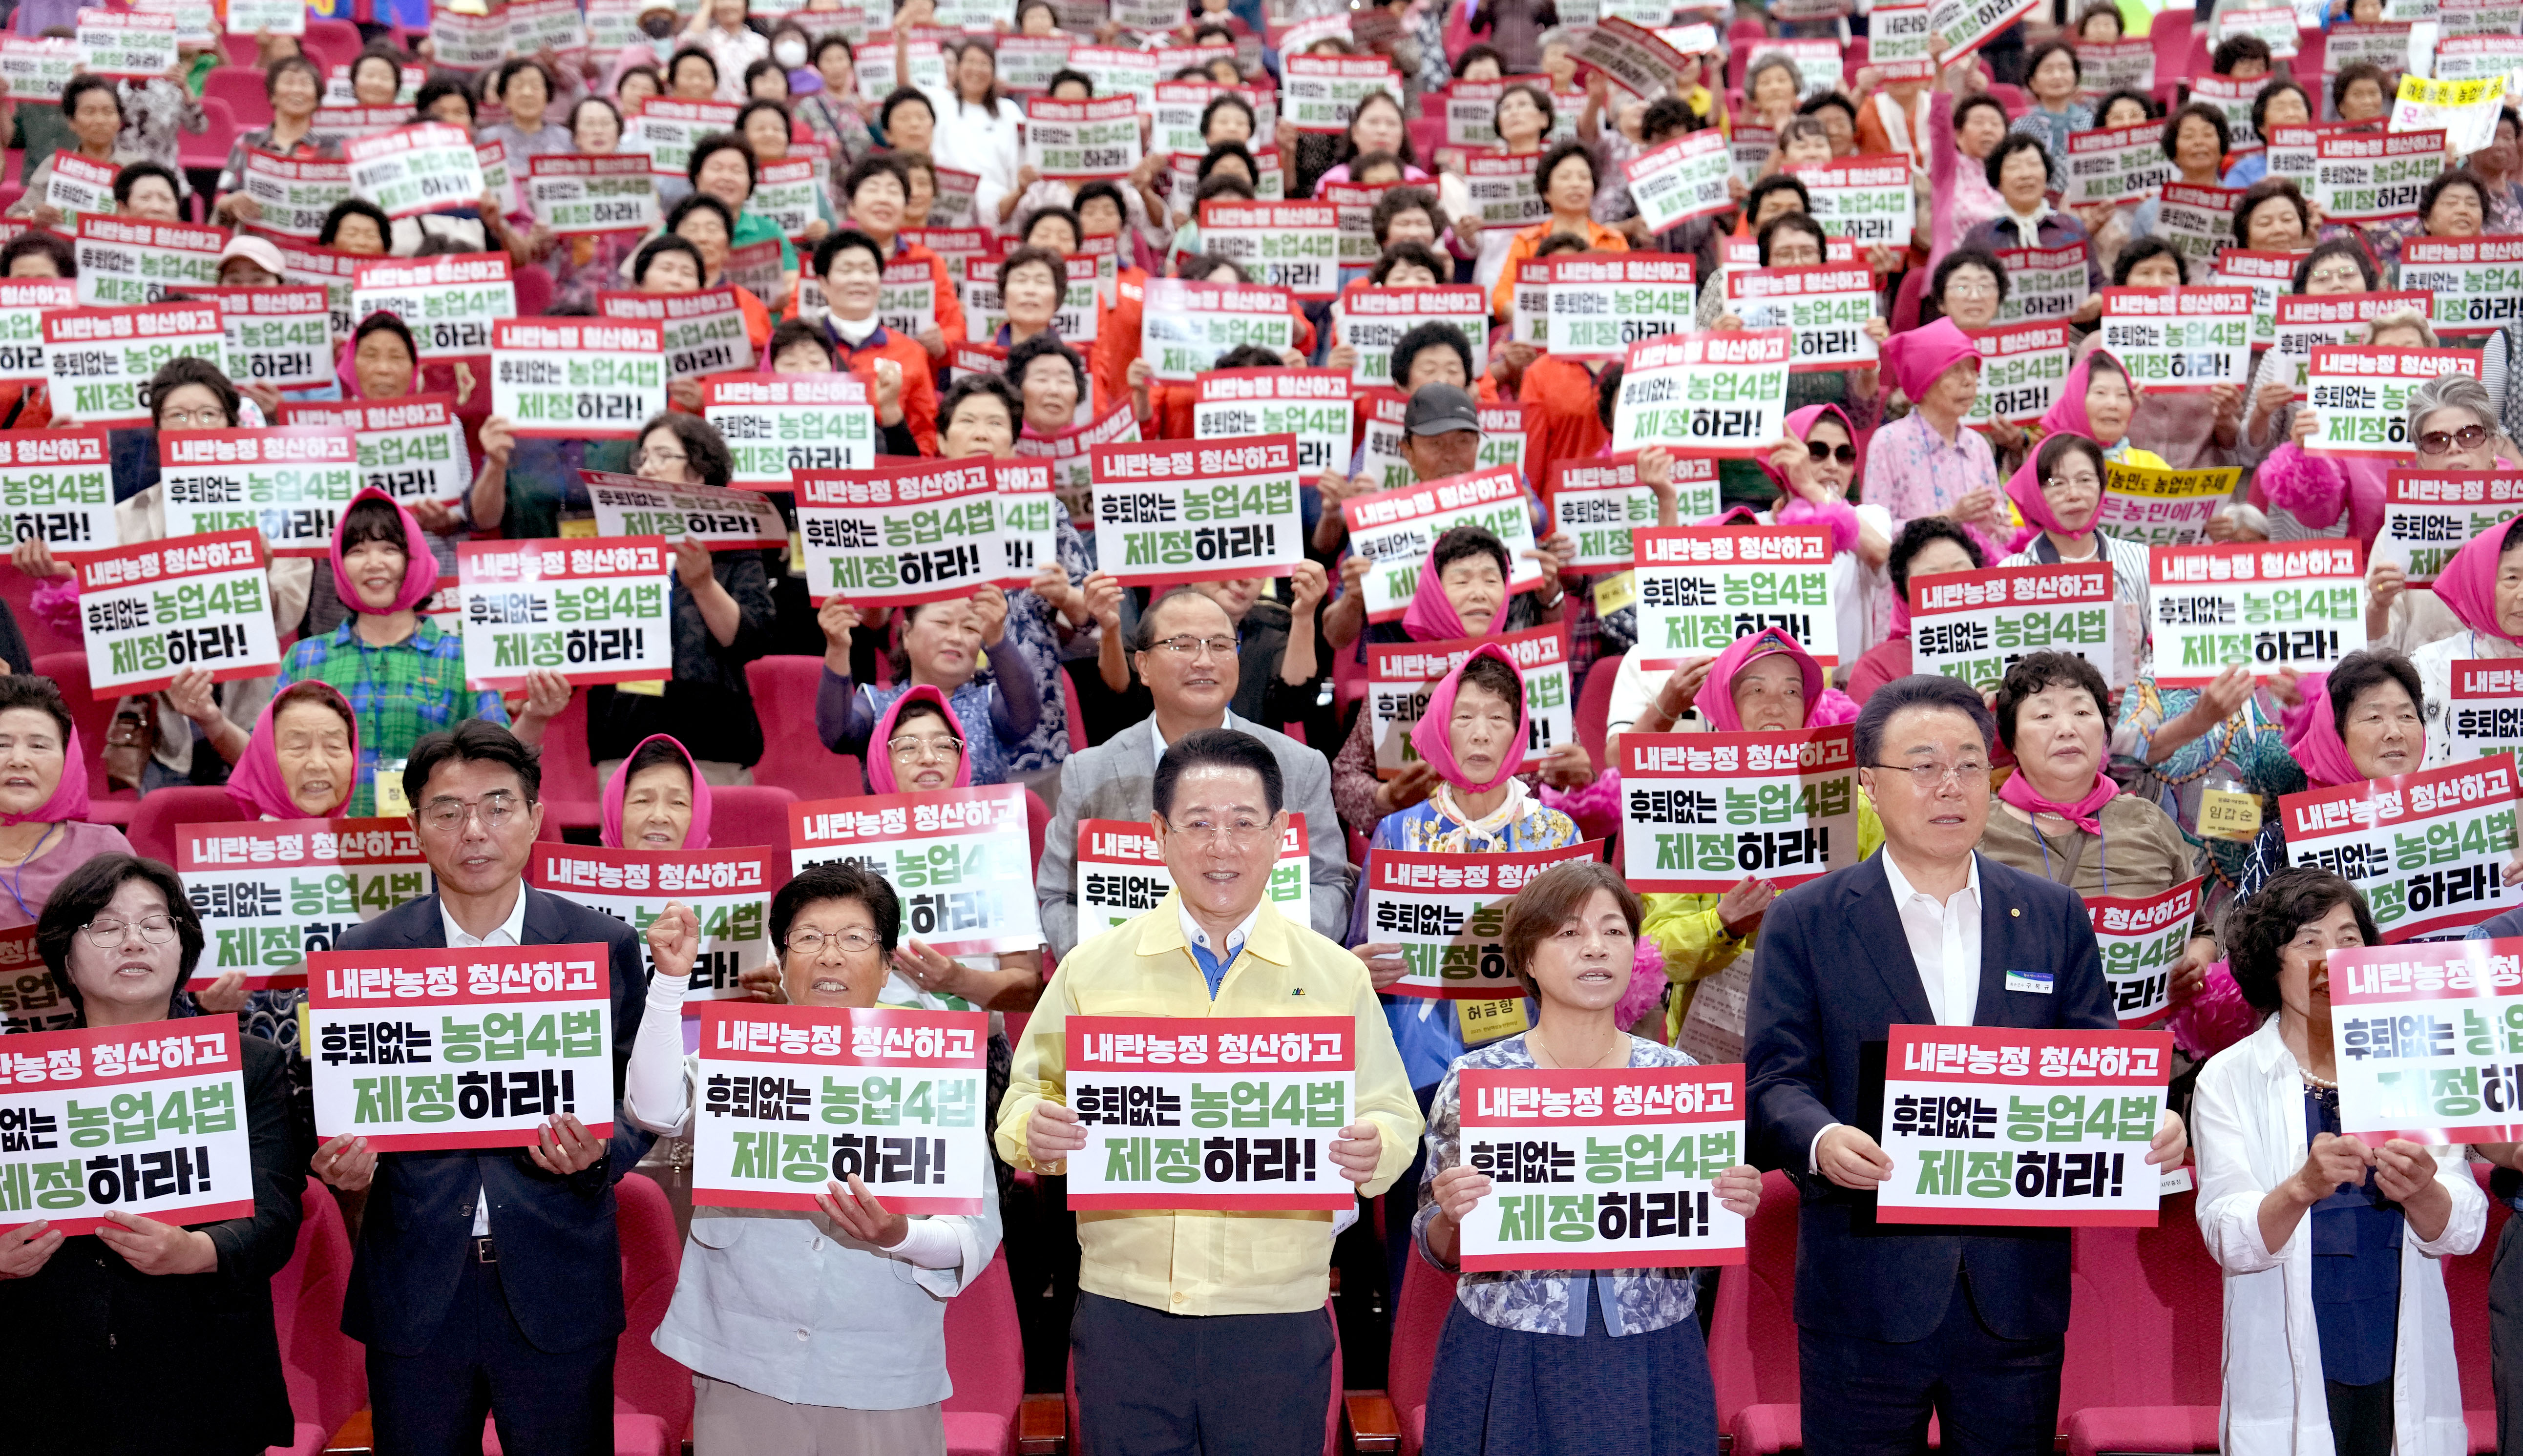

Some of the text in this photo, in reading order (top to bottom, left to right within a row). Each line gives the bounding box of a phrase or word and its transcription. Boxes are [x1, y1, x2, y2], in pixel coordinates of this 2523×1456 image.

[519, 394, 642, 419] 제정하라!
[1637, 402, 1761, 437] 제정하라!
[17, 438, 101, 462] 청산하고
[172, 435, 349, 461] 내란농정 청산하고
[1103, 452, 1194, 477] 내란농정
[1199, 445, 1289, 473] 청산하고
[3, 473, 105, 505] 농업4법
[171, 471, 352, 503] 후퇴없는 농업4법
[805, 466, 988, 502] 내란농정 청산하고
[1102, 480, 1292, 523] 후퇴없는 농업4법
[1357, 477, 1515, 527] 내란농정 청산하고
[2398, 479, 2483, 500] 내란농정
[807, 500, 994, 547] 후퇴없는 농업4법
[2392, 514, 2462, 540] 후퇴없는
[85, 541, 255, 587] 내란농정 청산하고
[471, 547, 659, 577] 내란농정 청산하고
[1125, 524, 1275, 564] 제정하라!
[1646, 536, 1824, 561] 내란농정 청산하고
[830, 544, 980, 587] 제정하라!
[2162, 550, 2354, 581] 내란농정 청산하고
[88, 578, 262, 633] 후퇴없는 농업4법
[470, 584, 661, 624] 후퇴없는 농업4법
[1644, 573, 1827, 607] 후퇴없는 농업4법
[1922, 574, 2104, 609] 내란농정 청산하고
[2160, 588, 2357, 624] 후퇴없는 농업4법
[106, 623, 247, 675] 제정하라!
[494, 628, 643, 666] 제정하라!
[1920, 609, 2105, 652] 후퇴없는 농업4법
[2183, 630, 2338, 664] 제정하라!
[1635, 738, 1848, 771] 내란농정 청산하고
[804, 798, 1012, 841] 내란농정 청산하고
[1631, 777, 1850, 825] 후퇴없는 농업4법
[2297, 768, 2510, 832] 내란농정 청산하고
[193, 830, 419, 863] 내란농정 청산하고
[1656, 827, 1829, 871] 제정하라!
[2395, 810, 2519, 871] 농업4법
[548, 858, 761, 890] 내란농정 청산하고
[1385, 863, 1489, 888] 내란농정
[189, 872, 422, 919] 후퇴없는 농업4법
[2103, 889, 2192, 930] 청산하고
[1377, 901, 1464, 936] 후퇴없는
[327, 961, 597, 998] 내란농정 청산하고
[2347, 959, 2475, 994] 내란농정
[92, 1033, 228, 1076] 청산하고
[322, 1009, 601, 1066] 후퇴없는 농업4법
[717, 1020, 974, 1058] 내란농정 청산하고
[1084, 1033, 1342, 1064] 내란농정 청산하고
[2344, 1016, 2454, 1060] 후퇴없는
[1905, 1043, 2159, 1077] 내란농정 청산하고
[67, 1082, 236, 1149] 농업4법
[354, 1069, 576, 1122] 제정하라!
[706, 1074, 975, 1126] 후퇴없는 농업4법
[1077, 1081, 1344, 1128] 후퇴없는 농업4법
[1478, 1082, 1733, 1117] 내란농정 청산하고
[1893, 1095, 2157, 1144] 후퇴없는 농업4법
[732, 1132, 945, 1184] 제정하라!
[1105, 1137, 1315, 1183] 제정하라!
[1471, 1131, 1736, 1186] 후퇴없는 농업4법
[1916, 1150, 2124, 1198] 제정하라!
[1499, 1191, 1708, 1242] 제정하라!
